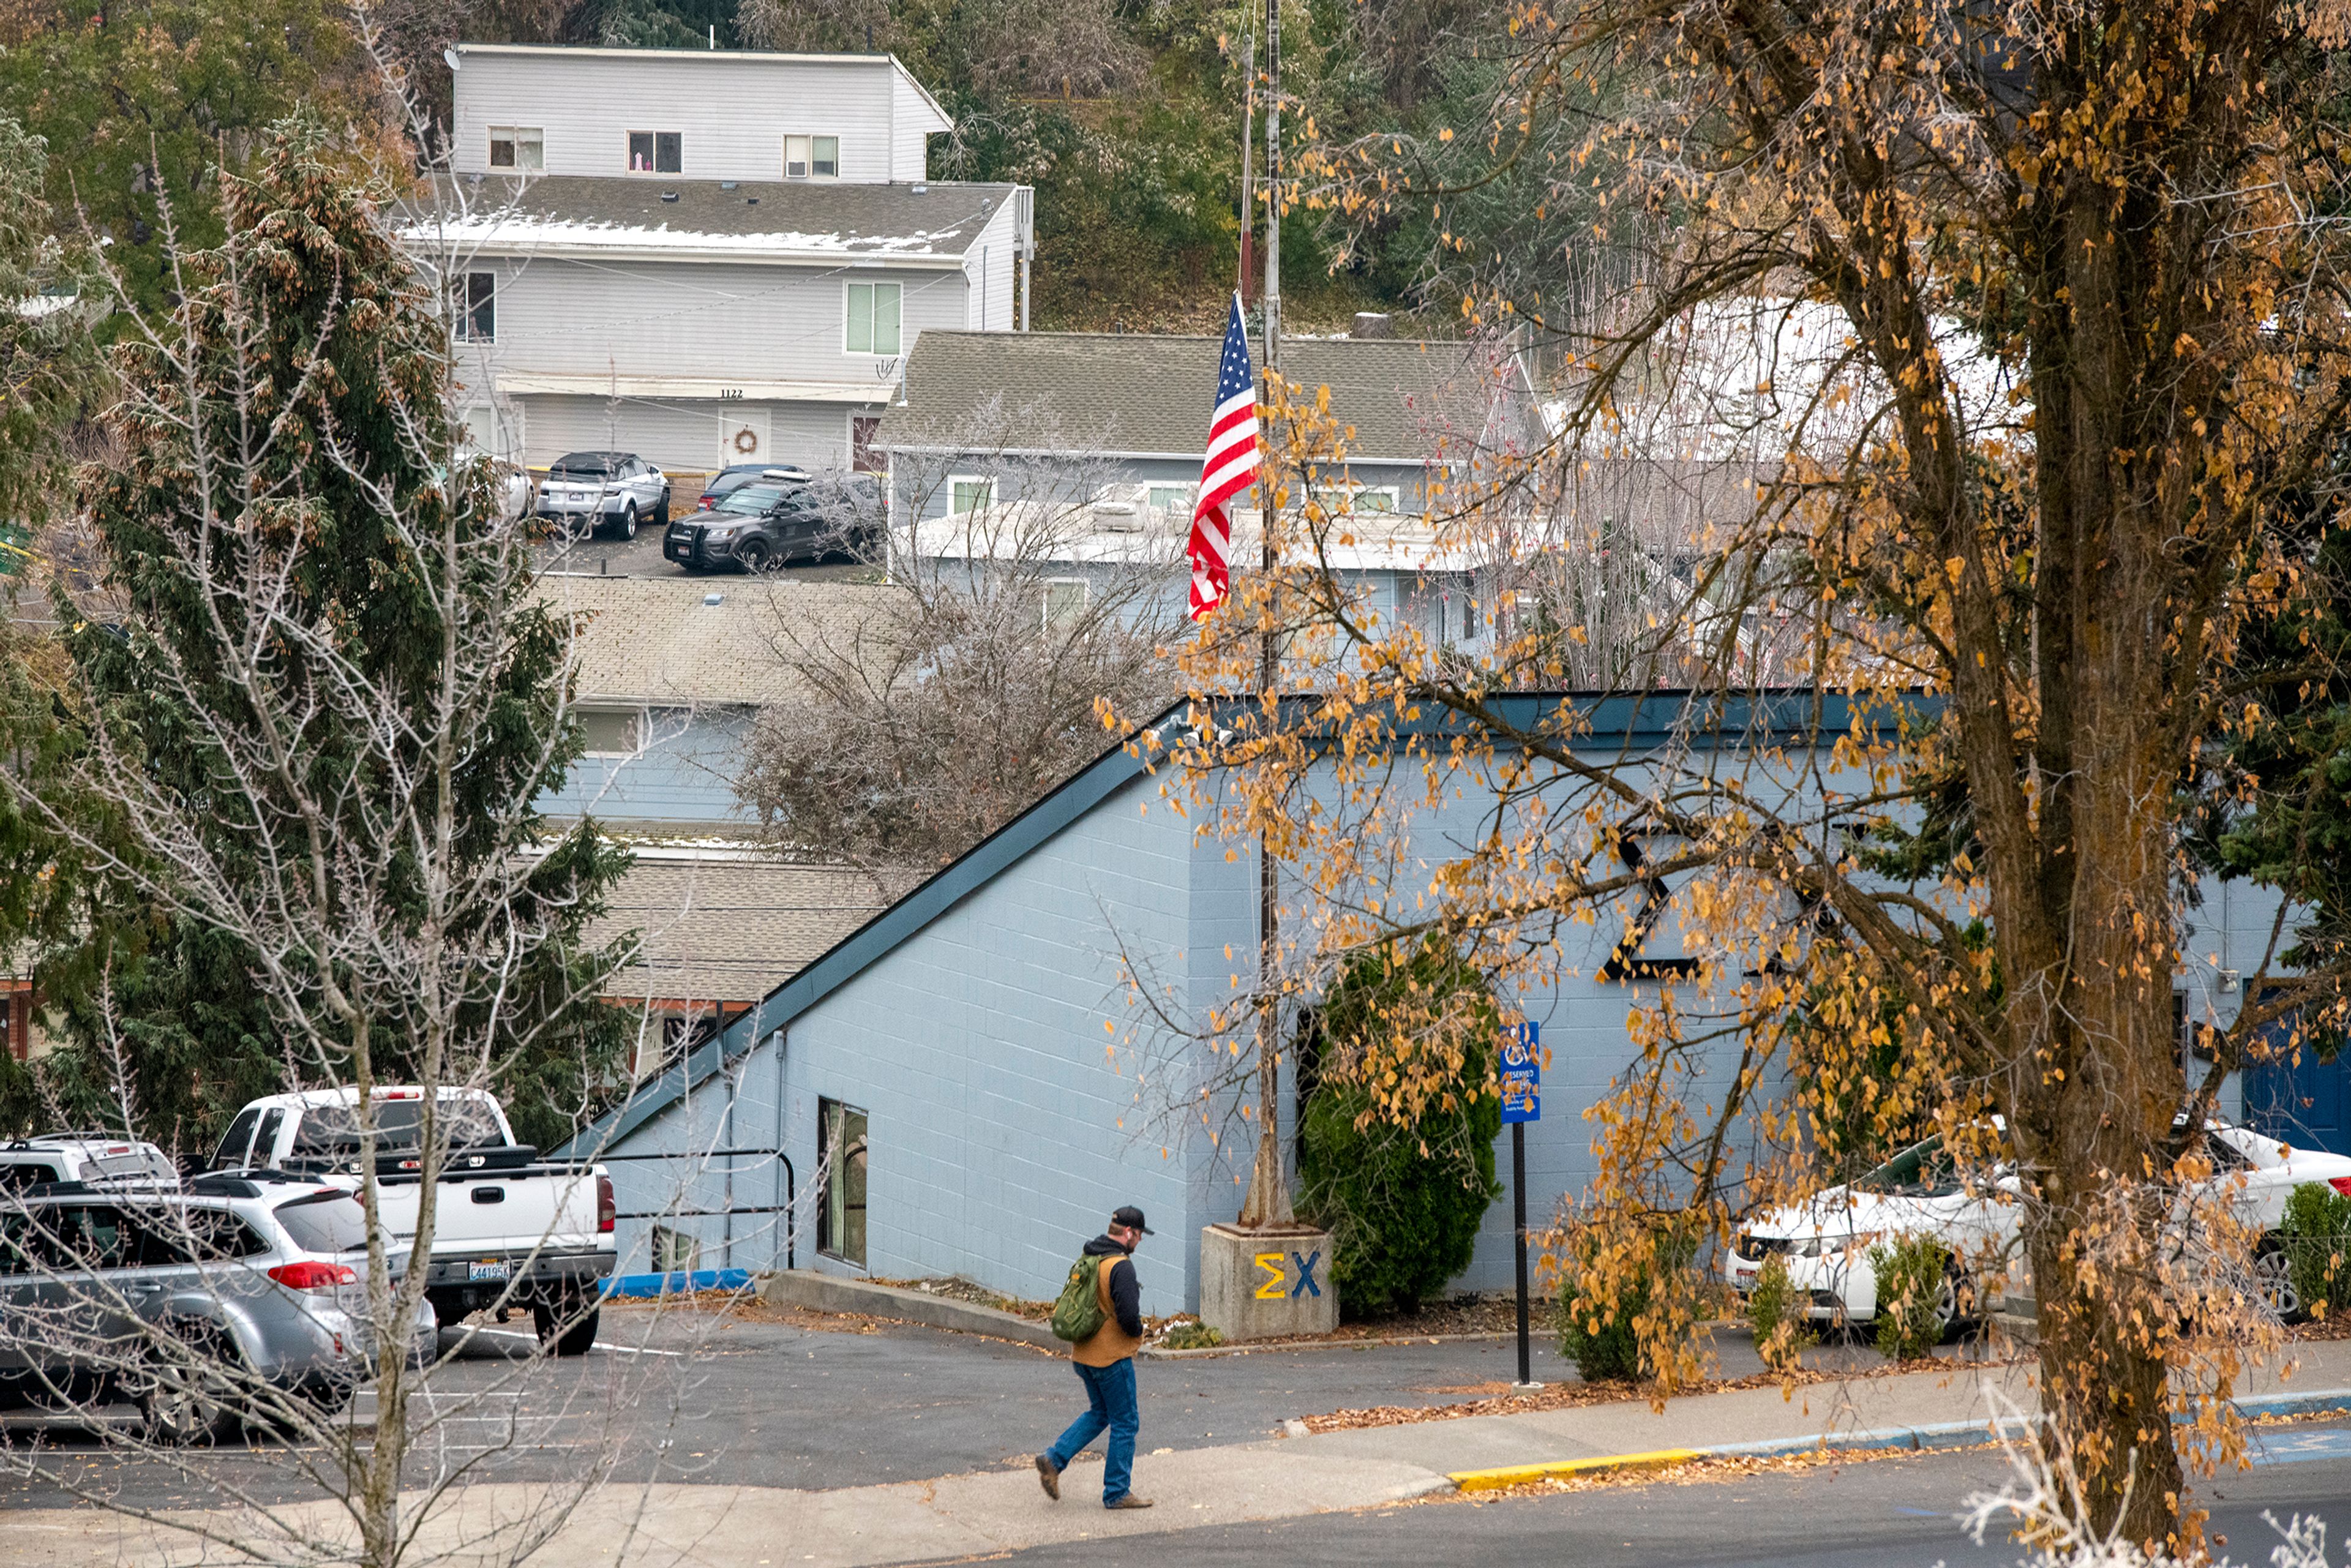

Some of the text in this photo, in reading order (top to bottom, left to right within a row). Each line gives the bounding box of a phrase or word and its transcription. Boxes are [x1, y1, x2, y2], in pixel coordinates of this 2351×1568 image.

[721, 389, 743, 399] 1122
[1505, 1070, 1534, 1078] ESERVED
[471, 1267, 508, 1279] C44195K
